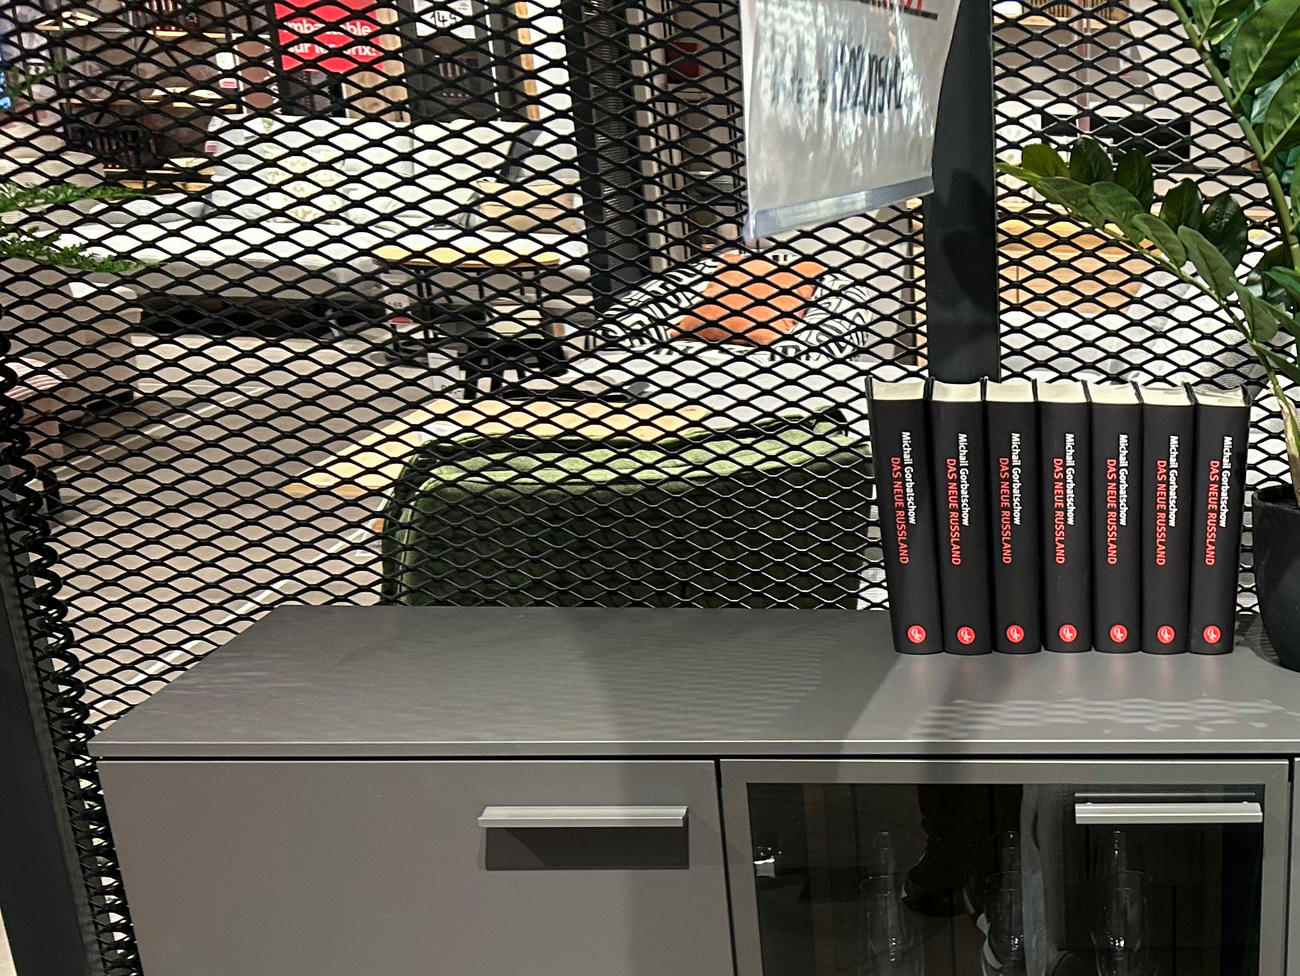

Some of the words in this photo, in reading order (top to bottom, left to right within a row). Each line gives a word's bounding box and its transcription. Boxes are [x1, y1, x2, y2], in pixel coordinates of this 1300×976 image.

[901, 431, 914, 465] Michail
[958, 433, 969, 467] Michail
[1011, 432, 1022, 466] Michail
[1065, 433, 1076, 467] Michail
[1118, 434, 1129, 468] Michail
[1168, 435, 1179, 469] Michail
[1221, 436, 1233, 469] Michail
[890, 457, 903, 479] DAS
[946, 458, 958, 480] DAS
[999, 457, 1010, 479] DAS
[1053, 457, 1064, 480] DAS
[1106, 458, 1118, 481] DAS
[1156, 459, 1167, 482] DAS
[1208, 460, 1221, 482] DAS
[893, 480, 905, 508] NEUE
[904, 465, 917, 525] Gorbatschow
[947, 481, 959, 510] NEUE
[959, 467, 971, 527] Gorbatschow
[1000, 481, 1011, 508] NEUE
[1011, 466, 1023, 526] Gorbatschow
[1053, 481, 1065, 509] NEUE
[1065, 467, 1077, 526] Gorbatschow
[1106, 482, 1118, 509] NEUE
[1118, 467, 1129, 526] Gorbatschow
[1156, 483, 1167, 511] NEUE
[1168, 469, 1179, 528] Gorbatschow
[1207, 483, 1219, 511] NEUE
[1218, 469, 1231, 528] Gorbatschow
[895, 510, 910, 565] RUSSLAND
[949, 511, 962, 566] RUSSLAND
[1000, 510, 1012, 564] RUSSLAND
[1054, 510, 1066, 565] RUSSLAND
[1106, 510, 1118, 565] RUSSLAND
[1155, 511, 1167, 566] RUSSLAND
[1204, 511, 1218, 566] RUSSLAND
